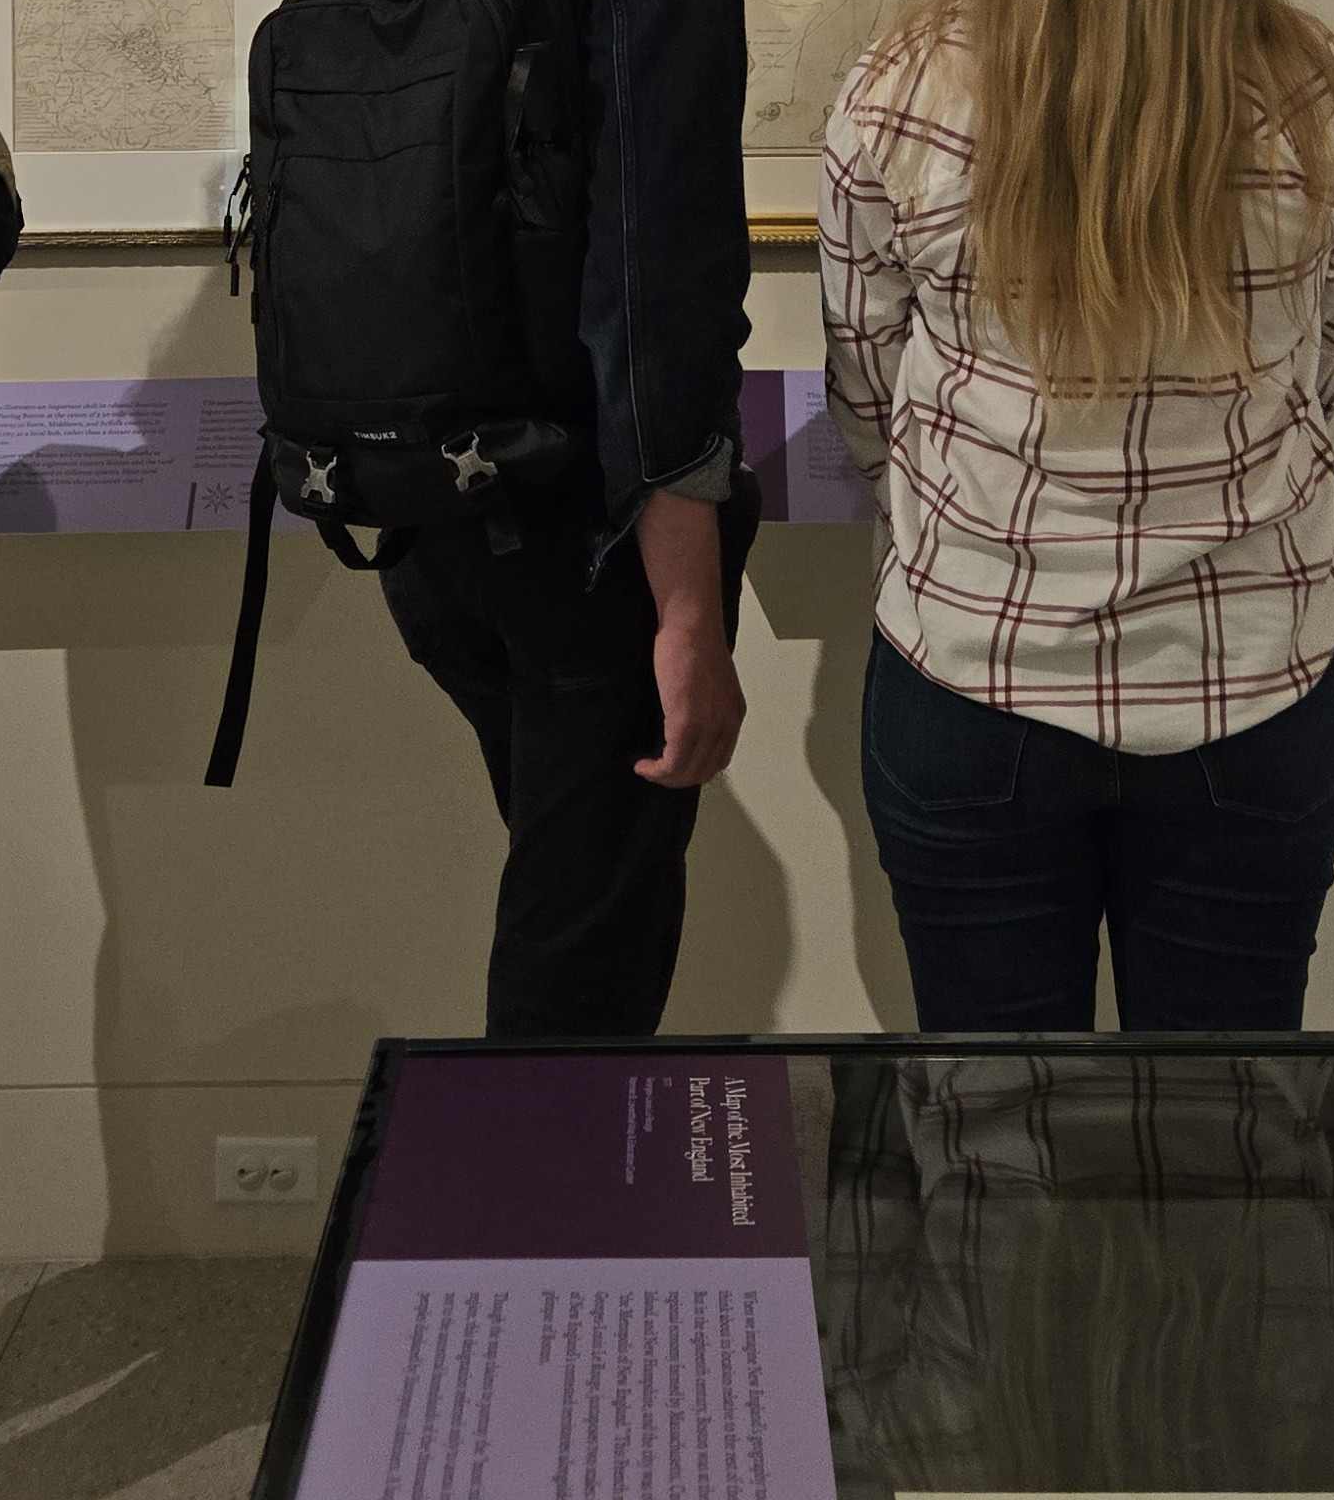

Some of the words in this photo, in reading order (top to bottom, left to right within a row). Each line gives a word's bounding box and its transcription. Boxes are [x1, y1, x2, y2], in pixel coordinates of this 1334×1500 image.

[689, 1076, 712, 1098] Part
[724, 1075, 746, 1086] A
[689, 1097, 712, 1110] of
[720, 1086, 748, 1110] Map
[690, 1109, 712, 1136] New
[727, 1110, 749, 1124] of
[727, 1122, 750, 1140] the
[683, 1136, 715, 1184] England
[728, 1140, 752, 1170] Most
[729, 1170, 756, 1227] Inhabited
